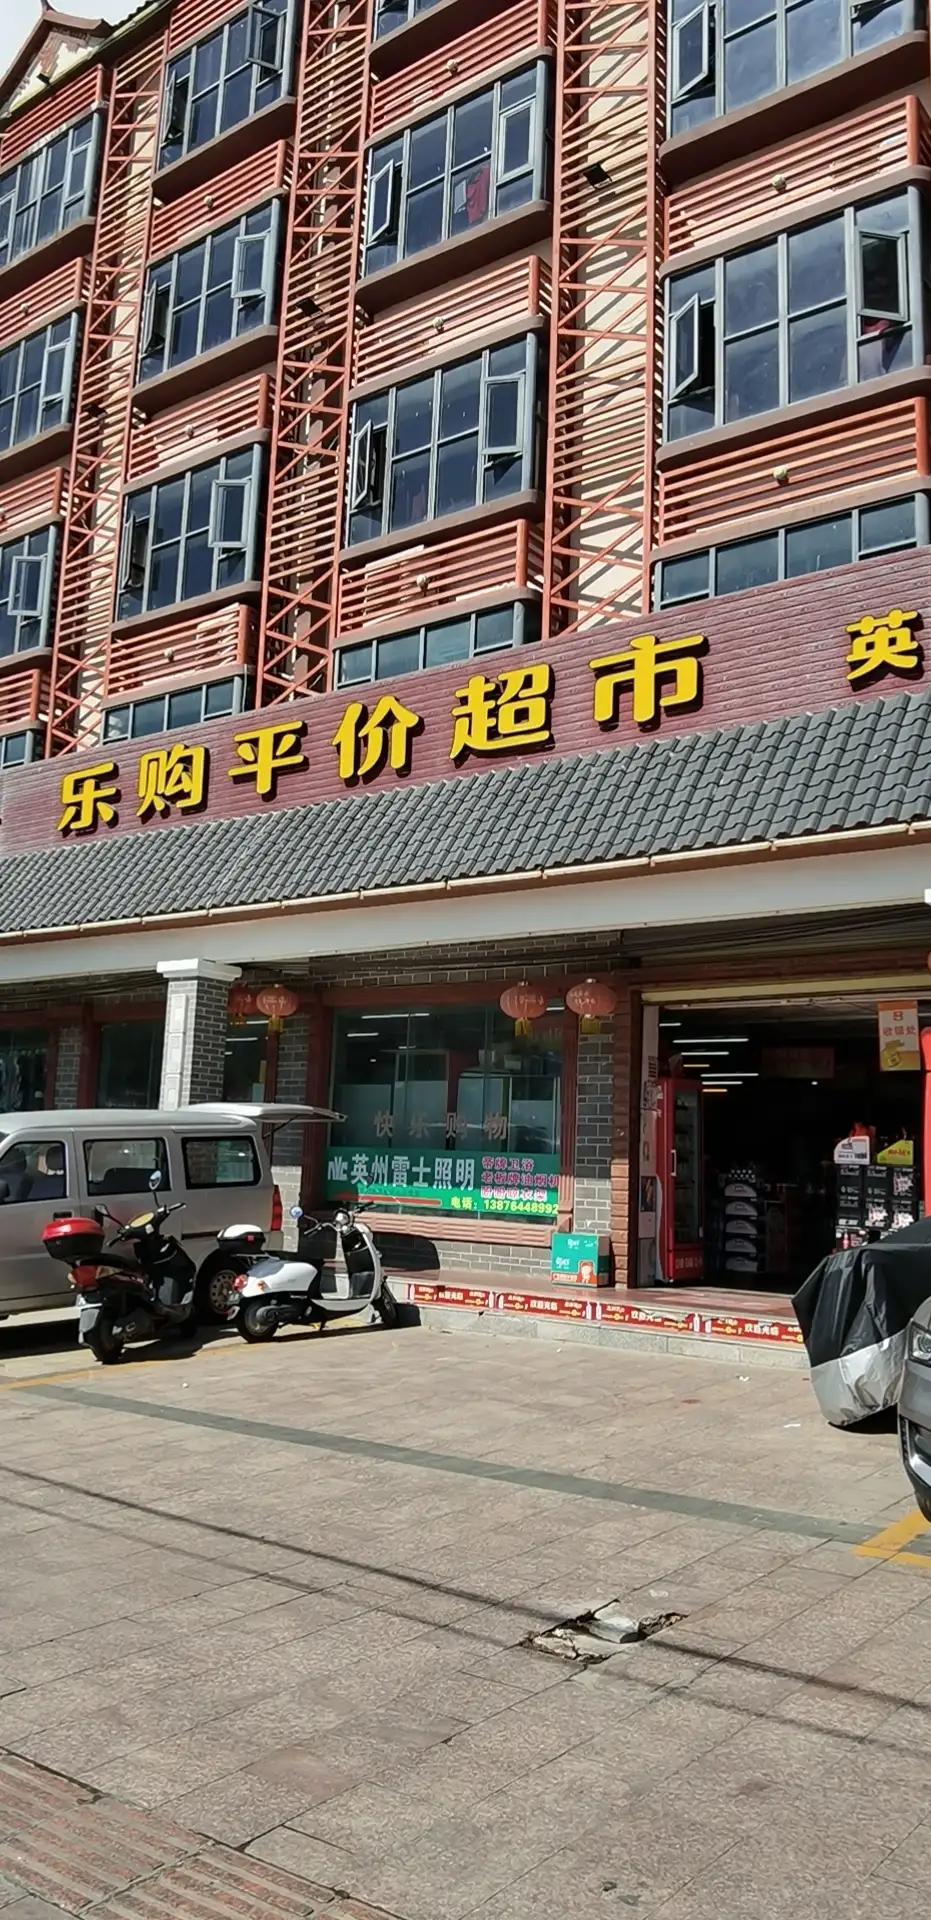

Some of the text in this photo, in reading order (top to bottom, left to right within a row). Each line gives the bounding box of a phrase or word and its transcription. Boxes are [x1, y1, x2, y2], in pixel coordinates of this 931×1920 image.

[846, 608, 919, 680] 英
[57, 634, 706, 831] 乐购平价超市
[373, 1111, 509, 1140] 快乐购物
[350, 1153, 475, 1191] 英州雷士照明
